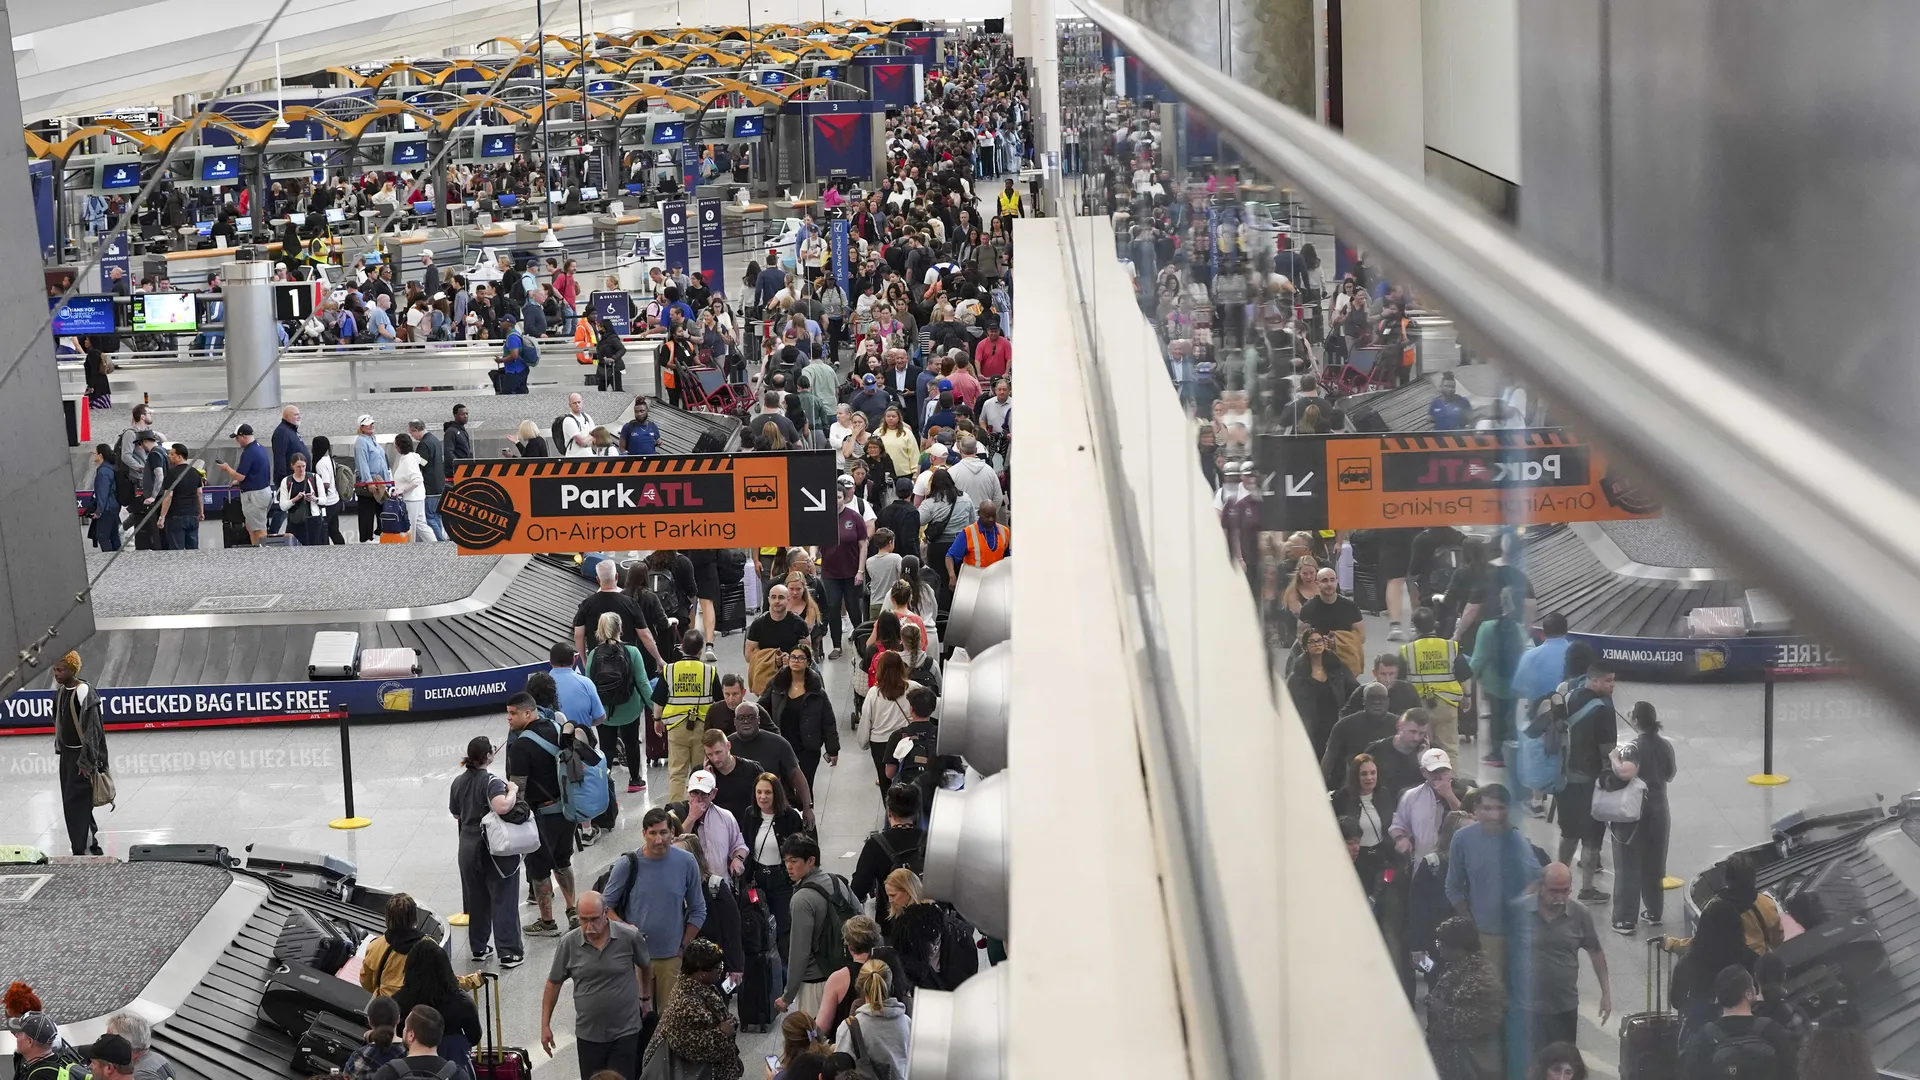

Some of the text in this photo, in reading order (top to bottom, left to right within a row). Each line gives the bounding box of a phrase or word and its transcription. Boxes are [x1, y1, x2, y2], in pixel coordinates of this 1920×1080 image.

[288, 288, 300, 316] 1
[446, 495, 509, 530] DETOUR
[526, 519, 736, 543] On-Airport Parking
[675, 683, 701, 692] OPERATIONS
[678, 673, 697, 682] AIRPORT
[424, 682, 507, 700] DELTA.COM/AMEX
[5, 698, 54, 718] YOUR
[110, 694, 192, 715] CHECKED
[196, 692, 233, 713] BAG
[236, 692, 283, 712] FLIES
